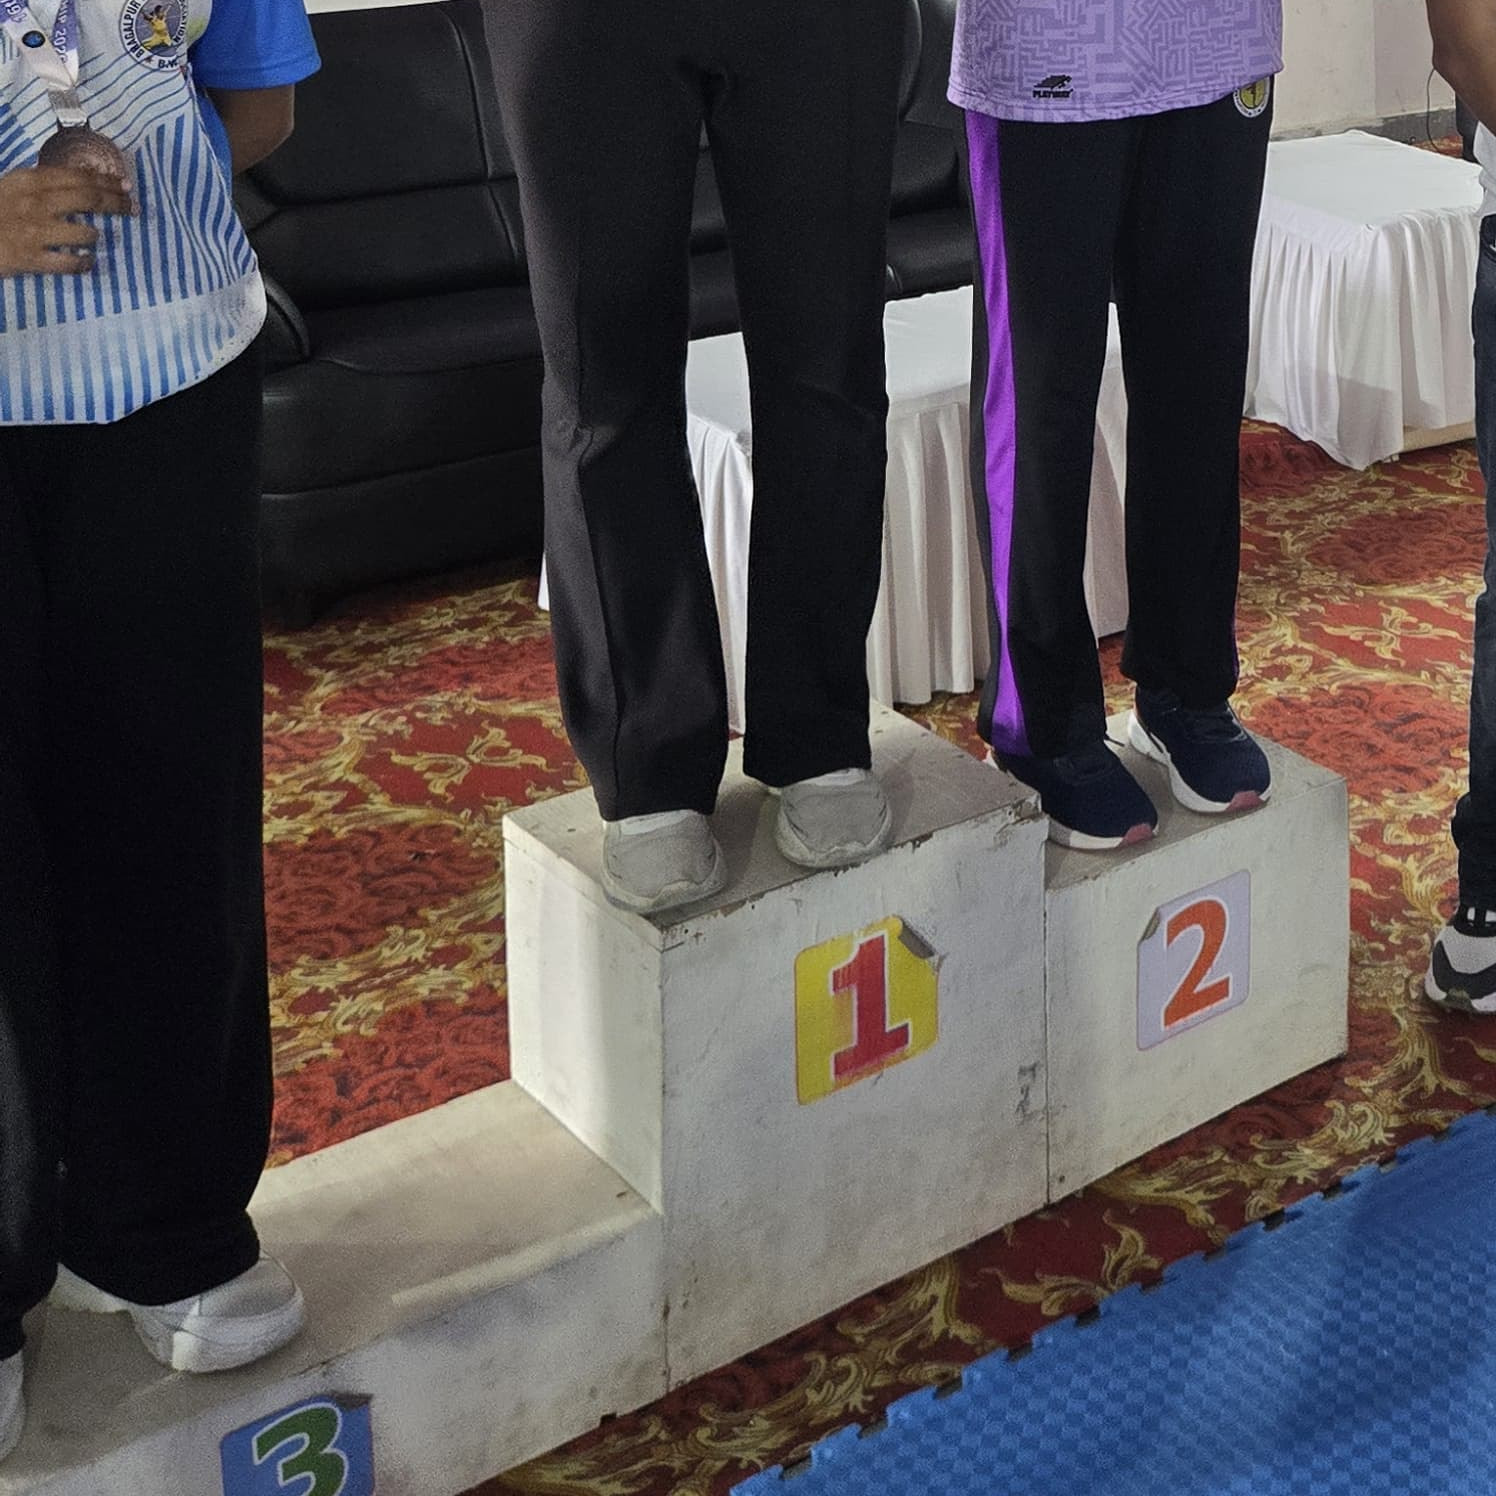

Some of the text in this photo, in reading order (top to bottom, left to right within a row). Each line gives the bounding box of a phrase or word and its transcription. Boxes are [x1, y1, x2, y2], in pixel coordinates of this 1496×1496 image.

[832, 930, 911, 1083] 1
[1162, 895, 1231, 1031] 2
[252, 1403, 349, 1496] 3
